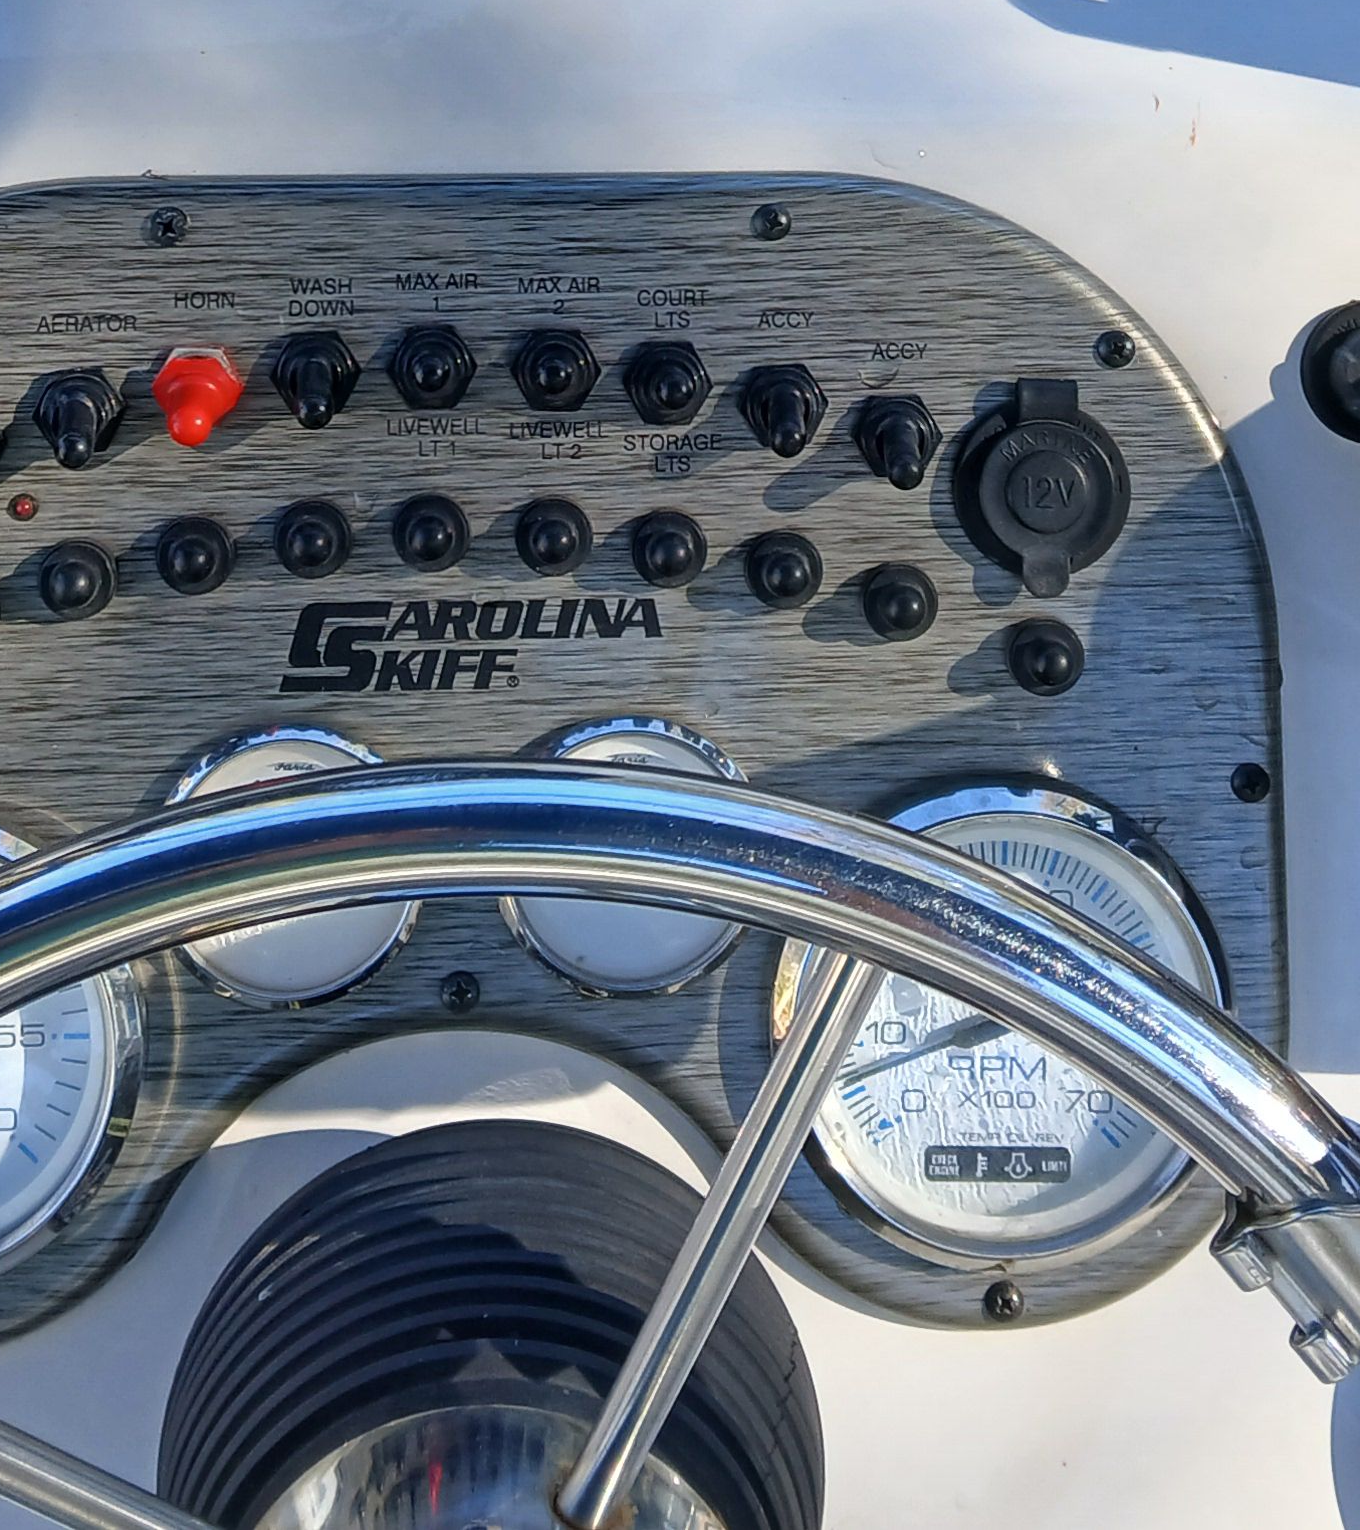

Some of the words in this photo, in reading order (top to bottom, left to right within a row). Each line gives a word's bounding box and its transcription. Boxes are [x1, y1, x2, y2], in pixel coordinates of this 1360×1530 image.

[290, 277, 353, 296] WASH
[395, 273, 440, 291] MAX
[445, 272, 479, 290] AIR
[517, 276, 562, 294] MAX
[566, 276, 600, 294] AIR
[173, 292, 236, 309] HORN
[431, 296, 441, 312] 1
[552, 298, 565, 315] 2
[637, 289, 710, 307] COURT
[288, 299, 355, 317] DOWN
[36, 314, 138, 334] AERATOR
[653, 311, 691, 328] LTS
[757, 311, 814, 329] ACCY
[871, 343, 928, 361] ACCY
[386, 419, 484, 437] LIVEWELL
[509, 421, 606, 439] LIVEWELL
[418, 440, 443, 457] LT
[540, 442, 565, 460] LT
[569, 442, 582, 460] 2
[623, 433, 722, 452] STORAGE
[653, 454, 691, 473] LTS
[1023, 476, 1075, 509] 12V
[288, 599, 663, 666] CAROLINA
[280, 627, 518, 692] SKIFF
[866, 1021, 907, 1046] 10
[948, 1055, 1047, 1081] RPM
[901, 1089, 927, 1113] 0
[958, 1091, 1036, 1110] X100
[1064, 1089, 1113, 1115] 70
